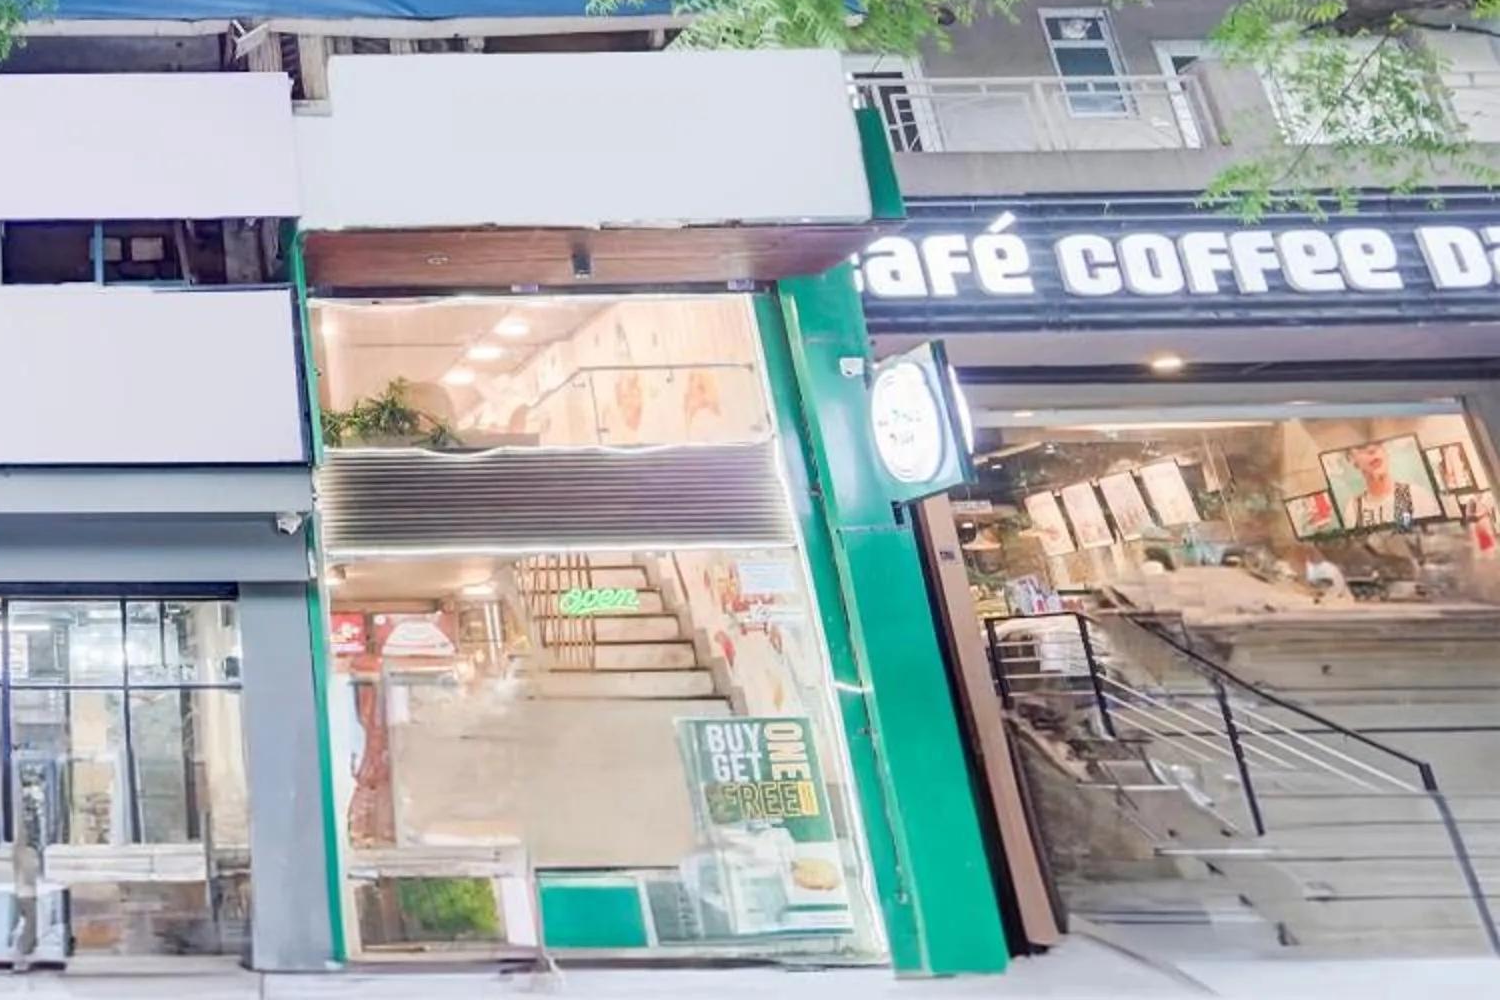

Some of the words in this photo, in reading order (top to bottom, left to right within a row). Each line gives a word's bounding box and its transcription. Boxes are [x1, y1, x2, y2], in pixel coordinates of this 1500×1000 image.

[704, 722, 762, 753] BUY
[763, 721, 812, 781] ONE
[710, 752, 763, 784] GET
[719, 781, 803, 819] FREE
